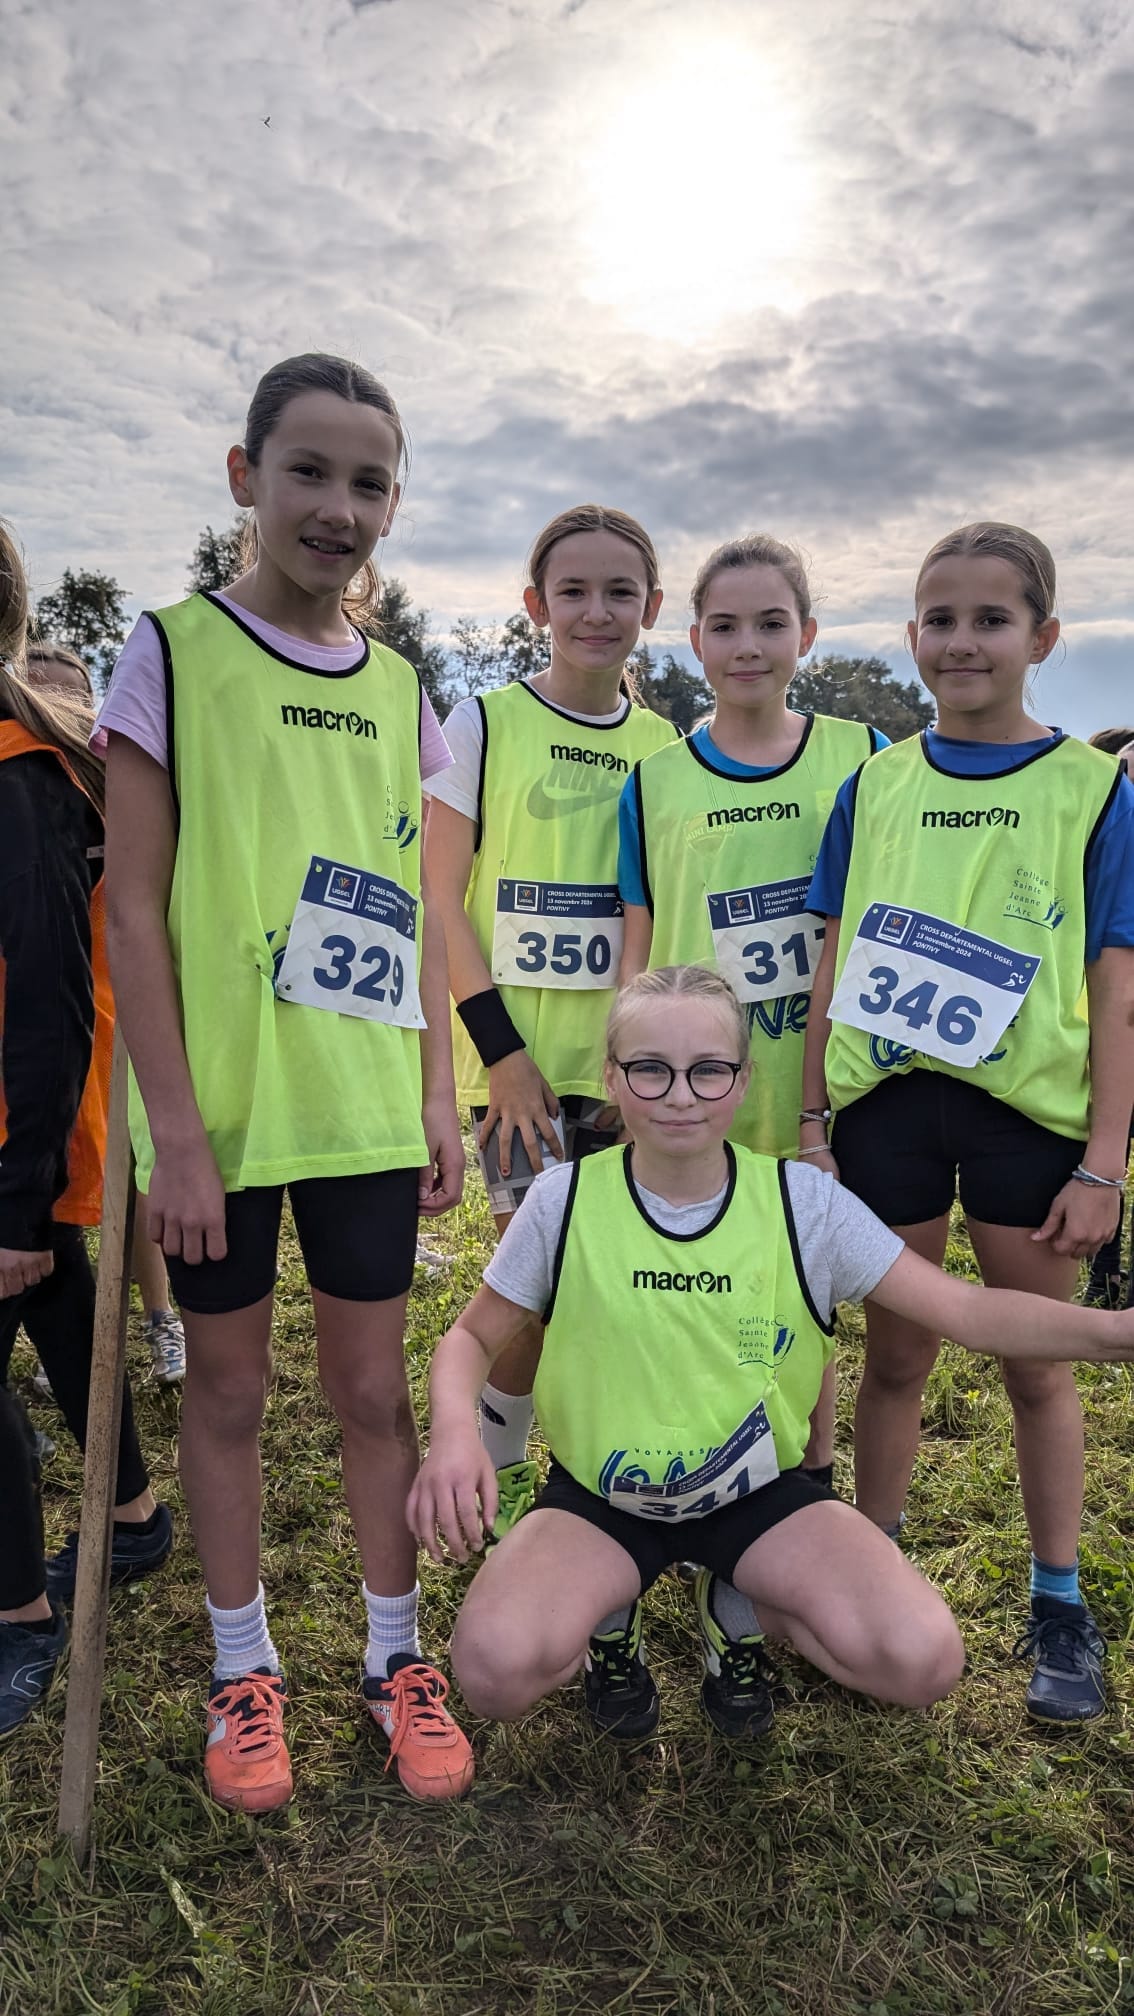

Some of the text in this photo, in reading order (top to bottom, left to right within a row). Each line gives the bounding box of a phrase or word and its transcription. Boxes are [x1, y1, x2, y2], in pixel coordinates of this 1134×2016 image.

[281, 704, 378, 740] macron
[550, 744, 629, 773] macron
[706, 801, 801, 828] macron
[921, 806, 1021, 829] macron
[369, 884, 386, 896] CROSS
[762, 891, 780, 900] CROSS
[1013, 879, 1042, 895] Sainte
[364, 904, 389, 917] PONTIVY
[764, 905, 790, 915] PONTIVY
[515, 931, 611, 975] 350
[742, 927, 826, 985] 31
[911, 940, 941, 955] PONTIVY
[919, 923, 1014, 967] CROSS DEPARTEMENTAL UGSEL
[924, 934, 956, 952] novembre
[955, 947, 972, 958] 2024
[313, 934, 404, 1007] 329
[858, 965, 983, 1046] 346
[632, 1269, 732, 1294] macron
[634, 1447, 705, 1457] VOYAGES
[638, 1466, 751, 1517] 341
